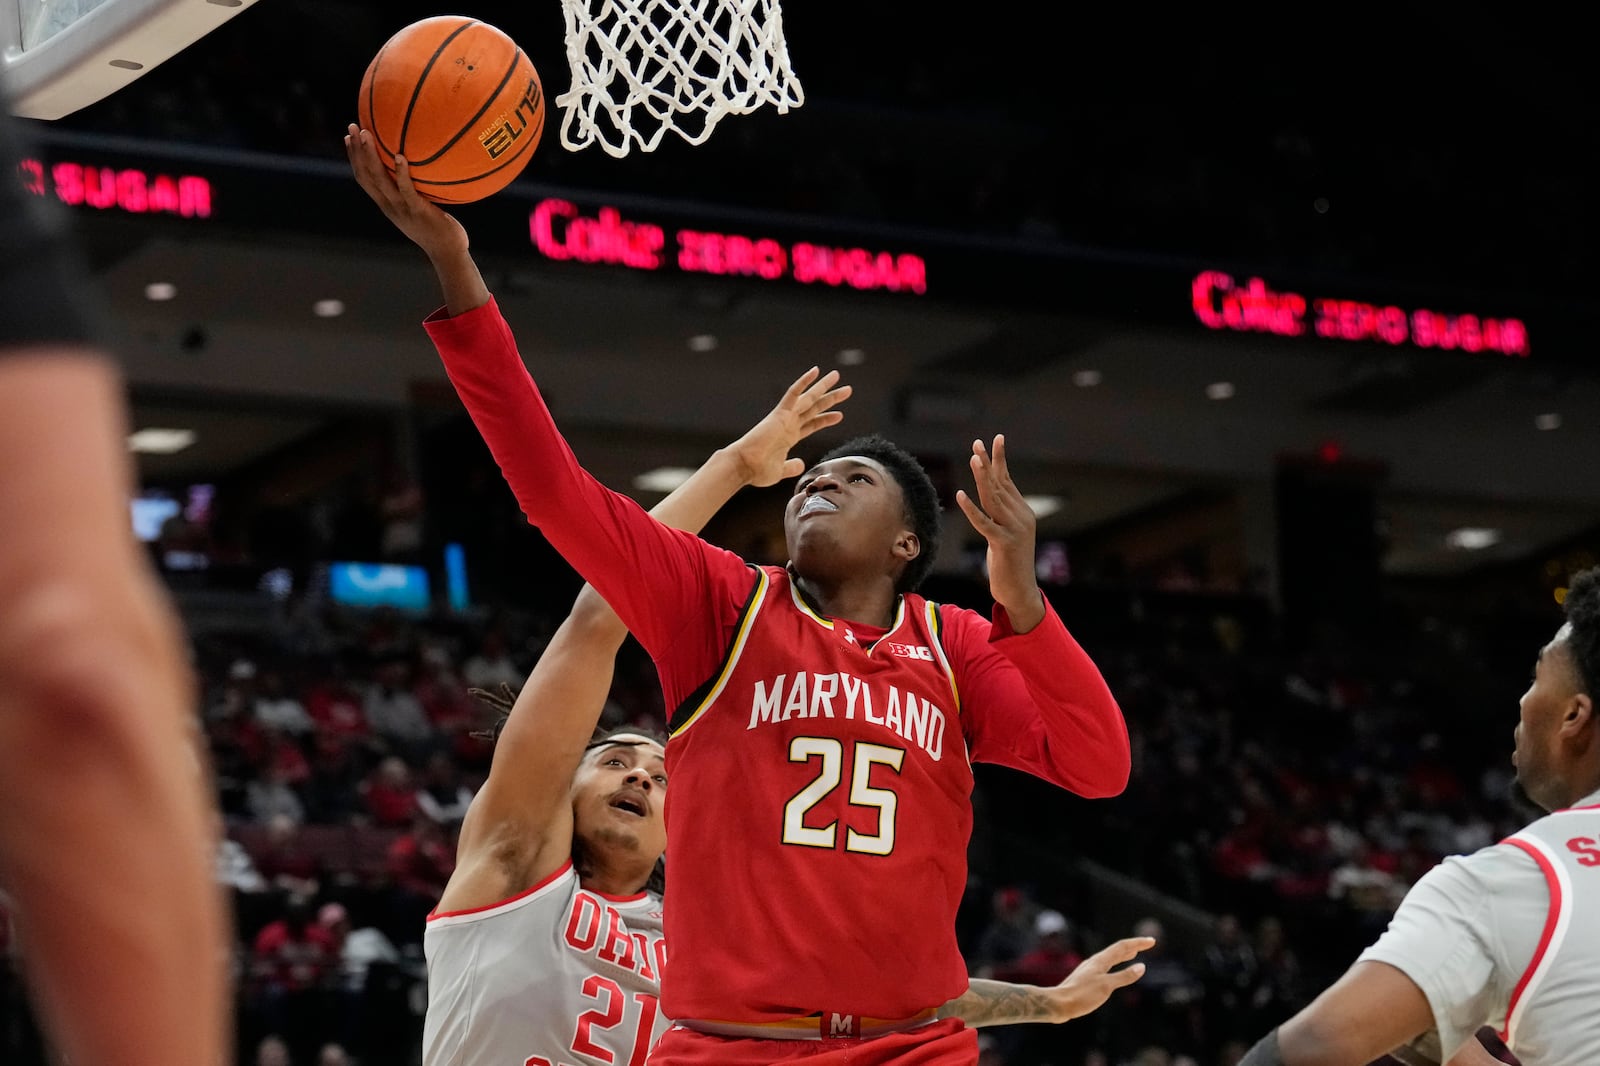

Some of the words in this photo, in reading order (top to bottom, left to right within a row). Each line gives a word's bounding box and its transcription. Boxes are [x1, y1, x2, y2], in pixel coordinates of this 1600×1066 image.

[482, 78, 541, 160] ELITE
[53, 162, 212, 217] SUGAR
[529, 198, 665, 270] Coke
[676, 229, 788, 280] ZERO
[792, 242, 927, 294] SUGAR
[1191, 270, 1307, 336] Coke
[1314, 298, 1408, 345] ZERO
[1411, 309, 1528, 356] SUGAR
[747, 671, 946, 762] MARYLAND
[782, 735, 906, 857] 25
[1565, 833, 1600, 867] S
[571, 974, 659, 1066] 21
[829, 1012, 854, 1036] M
